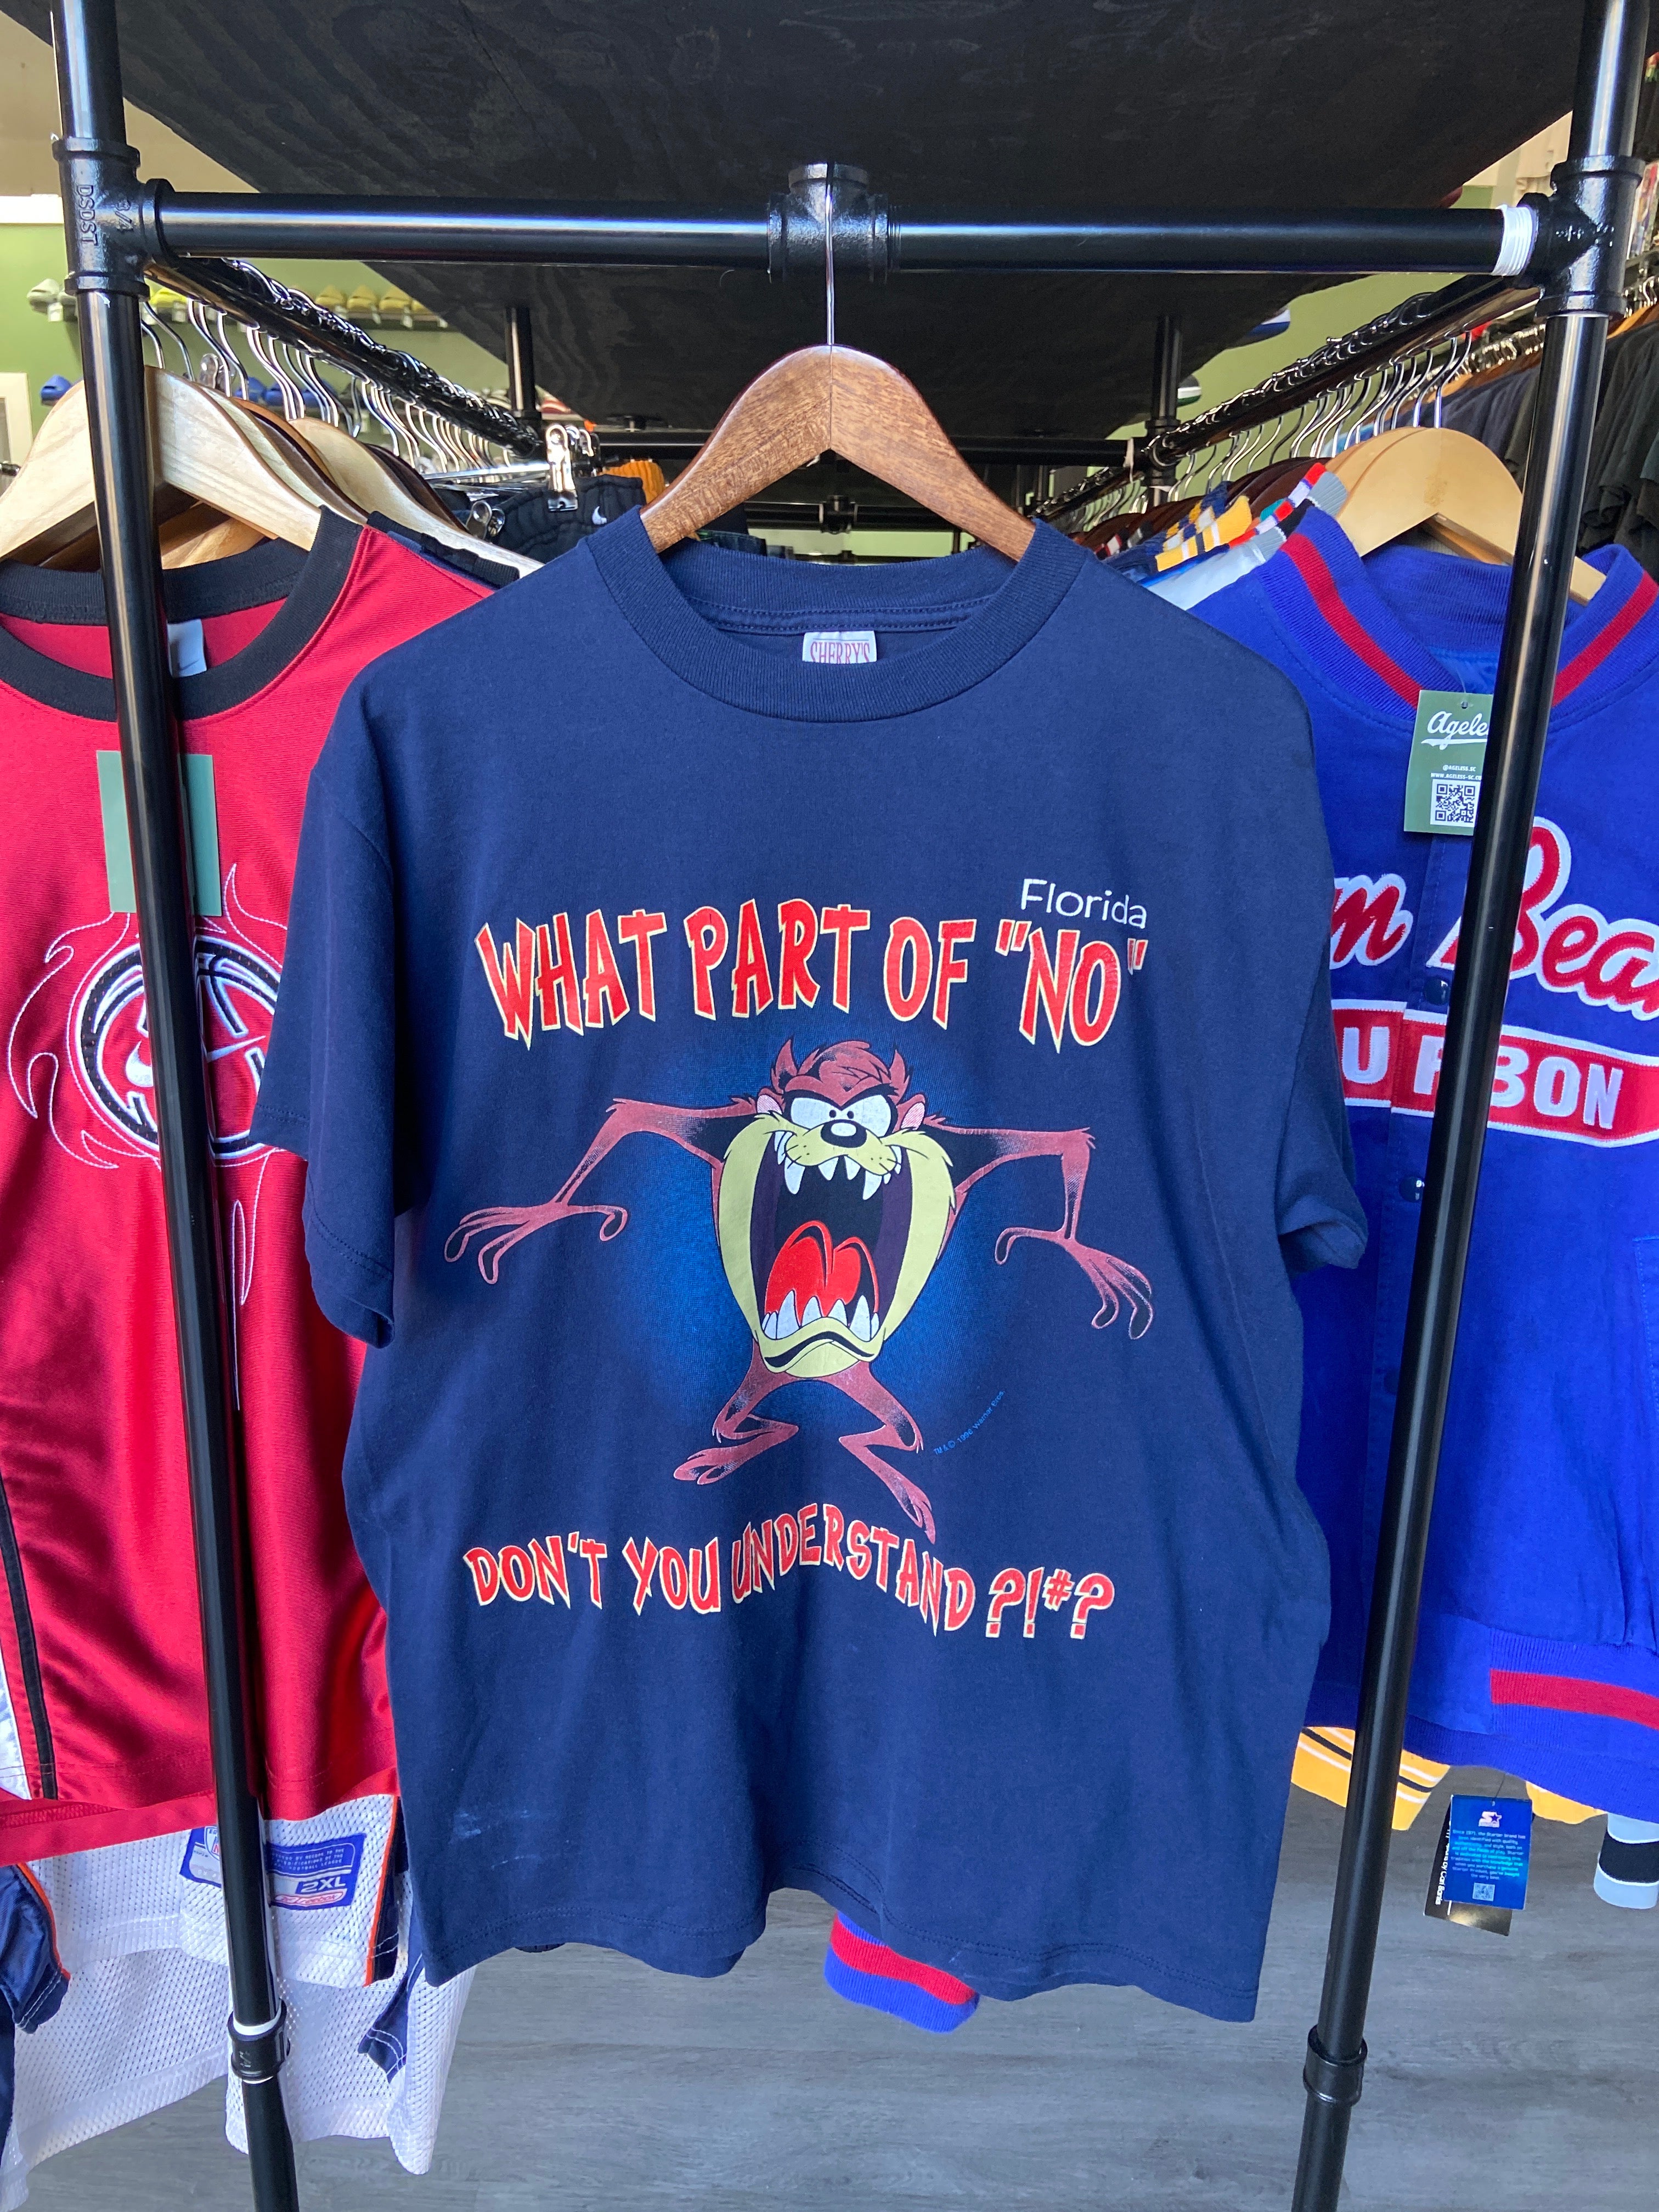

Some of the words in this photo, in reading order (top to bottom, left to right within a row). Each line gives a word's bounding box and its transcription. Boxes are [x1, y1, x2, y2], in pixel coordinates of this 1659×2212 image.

[77, 184, 99, 246] DSDST
[1427, 711, 1489, 751] Agele
[1430, 772, 1482, 781] WWW.AGELESS-SC.CO
[1020, 878, 1147, 929] Florida
[475, 909, 667, 1051] WHAT
[683, 898, 871, 1021] PART
[883, 916, 977, 1030] OF
[995, 918, 1149, 1054] "NO"
[957, 1429, 973, 1443] 1996
[462, 1531, 608, 1610] DON'T
[622, 1536, 721, 1616] YOU
[731, 1502, 976, 1638] UNDERSTAND
[301, 1876, 346, 1893] 2XL
